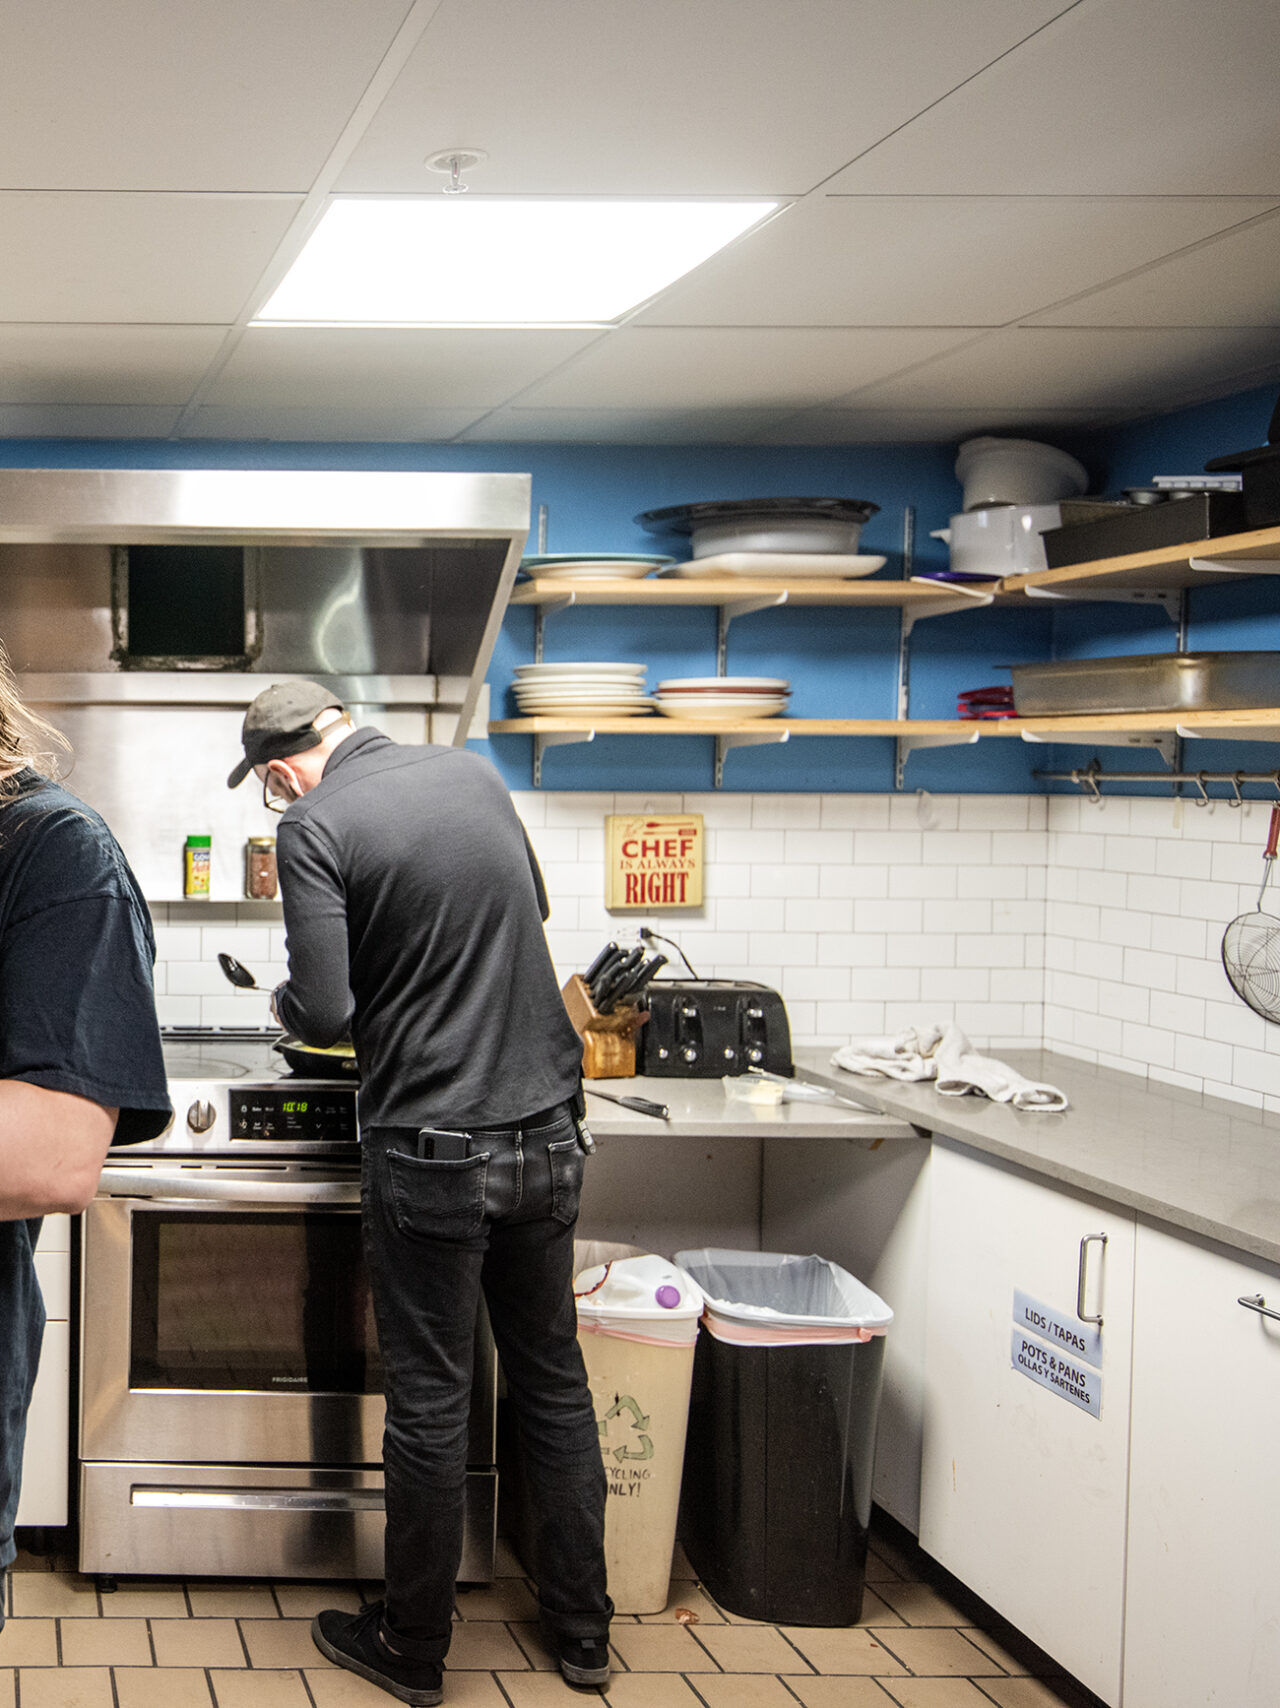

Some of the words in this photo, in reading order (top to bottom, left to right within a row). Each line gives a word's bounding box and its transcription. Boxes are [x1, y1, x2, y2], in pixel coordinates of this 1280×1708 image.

[621, 839, 693, 858] CHEF
[620, 860, 632, 870] IS
[637, 859, 696, 870] ALWAYS
[625, 872, 689, 904] RIGHT
[1025, 1307, 1046, 1329] LIDS
[1053, 1323, 1086, 1352] TAPAS
[1021, 1340, 1047, 1365] POTS
[1049, 1356, 1057, 1369] &
[1058, 1361, 1086, 1388] PANS
[272, 1376, 308, 1384] FRIGIDAIRE
[1017, 1353, 1043, 1376] OLLAS
[1044, 1368, 1050, 1378] Y
[1050, 1372, 1091, 1404] SARTENES
[606, 1466, 651, 1480] YCLING
[609, 1482, 641, 1498] NLY!
